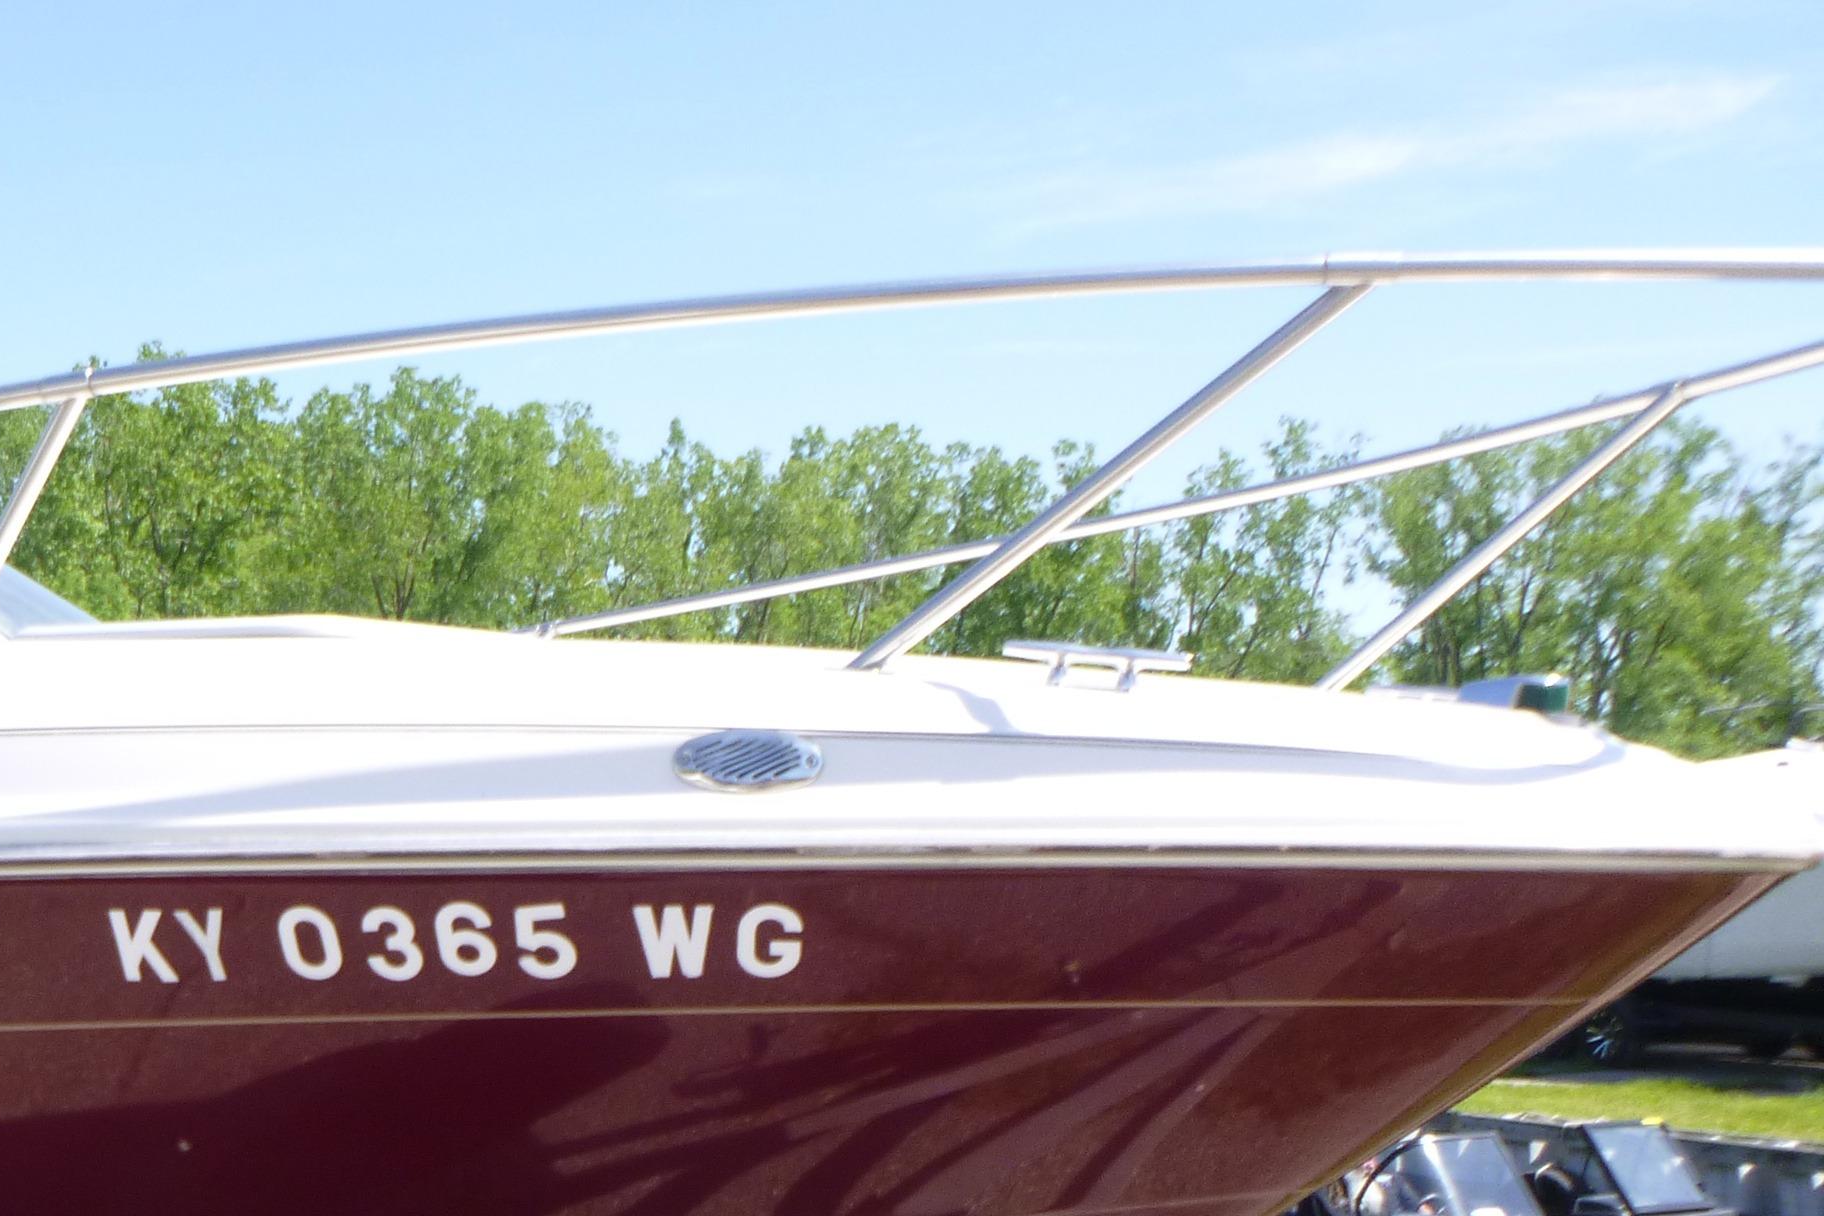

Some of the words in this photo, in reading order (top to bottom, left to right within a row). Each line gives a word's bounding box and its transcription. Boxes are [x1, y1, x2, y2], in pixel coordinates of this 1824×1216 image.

[108, 907, 227, 983] KY
[277, 901, 577, 982] 0365
[633, 902, 803, 980] WG
